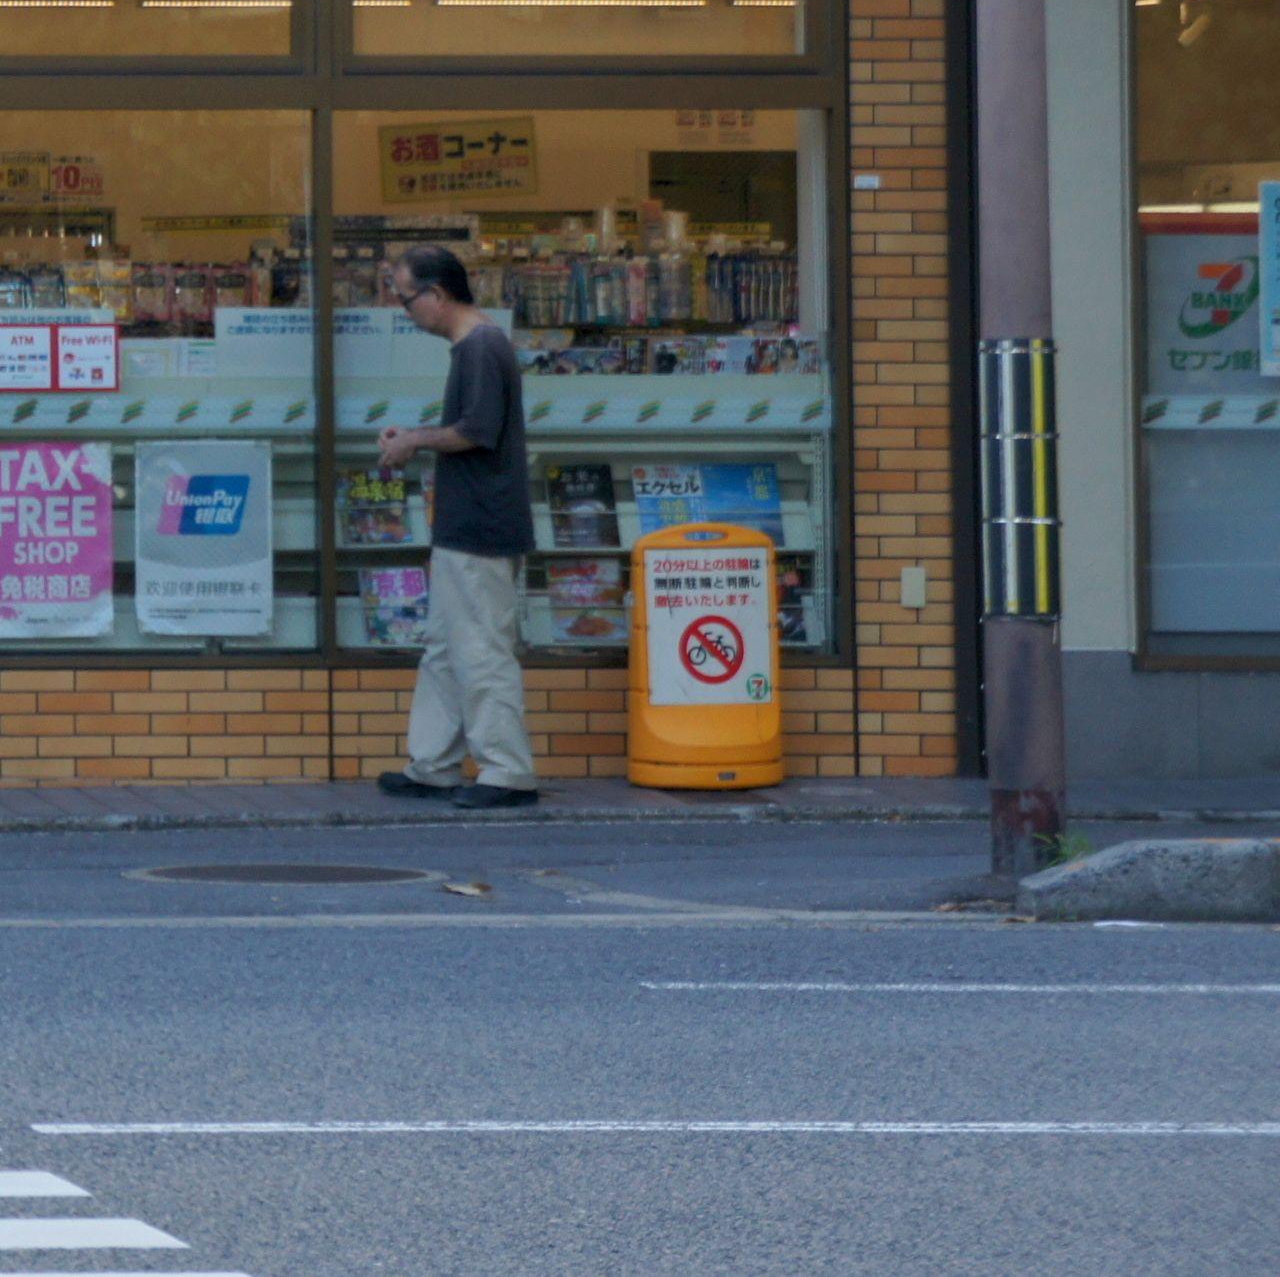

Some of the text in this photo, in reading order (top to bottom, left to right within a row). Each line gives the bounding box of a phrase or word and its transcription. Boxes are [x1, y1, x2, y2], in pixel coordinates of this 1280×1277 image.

[10, 335, 35, 346] ATM
[61, 335, 83, 346] Free
[636, 481, 700, 496] エクセル
[165, 489, 243, 510] UnionPay
[13, 541, 80, 565] SHOP
